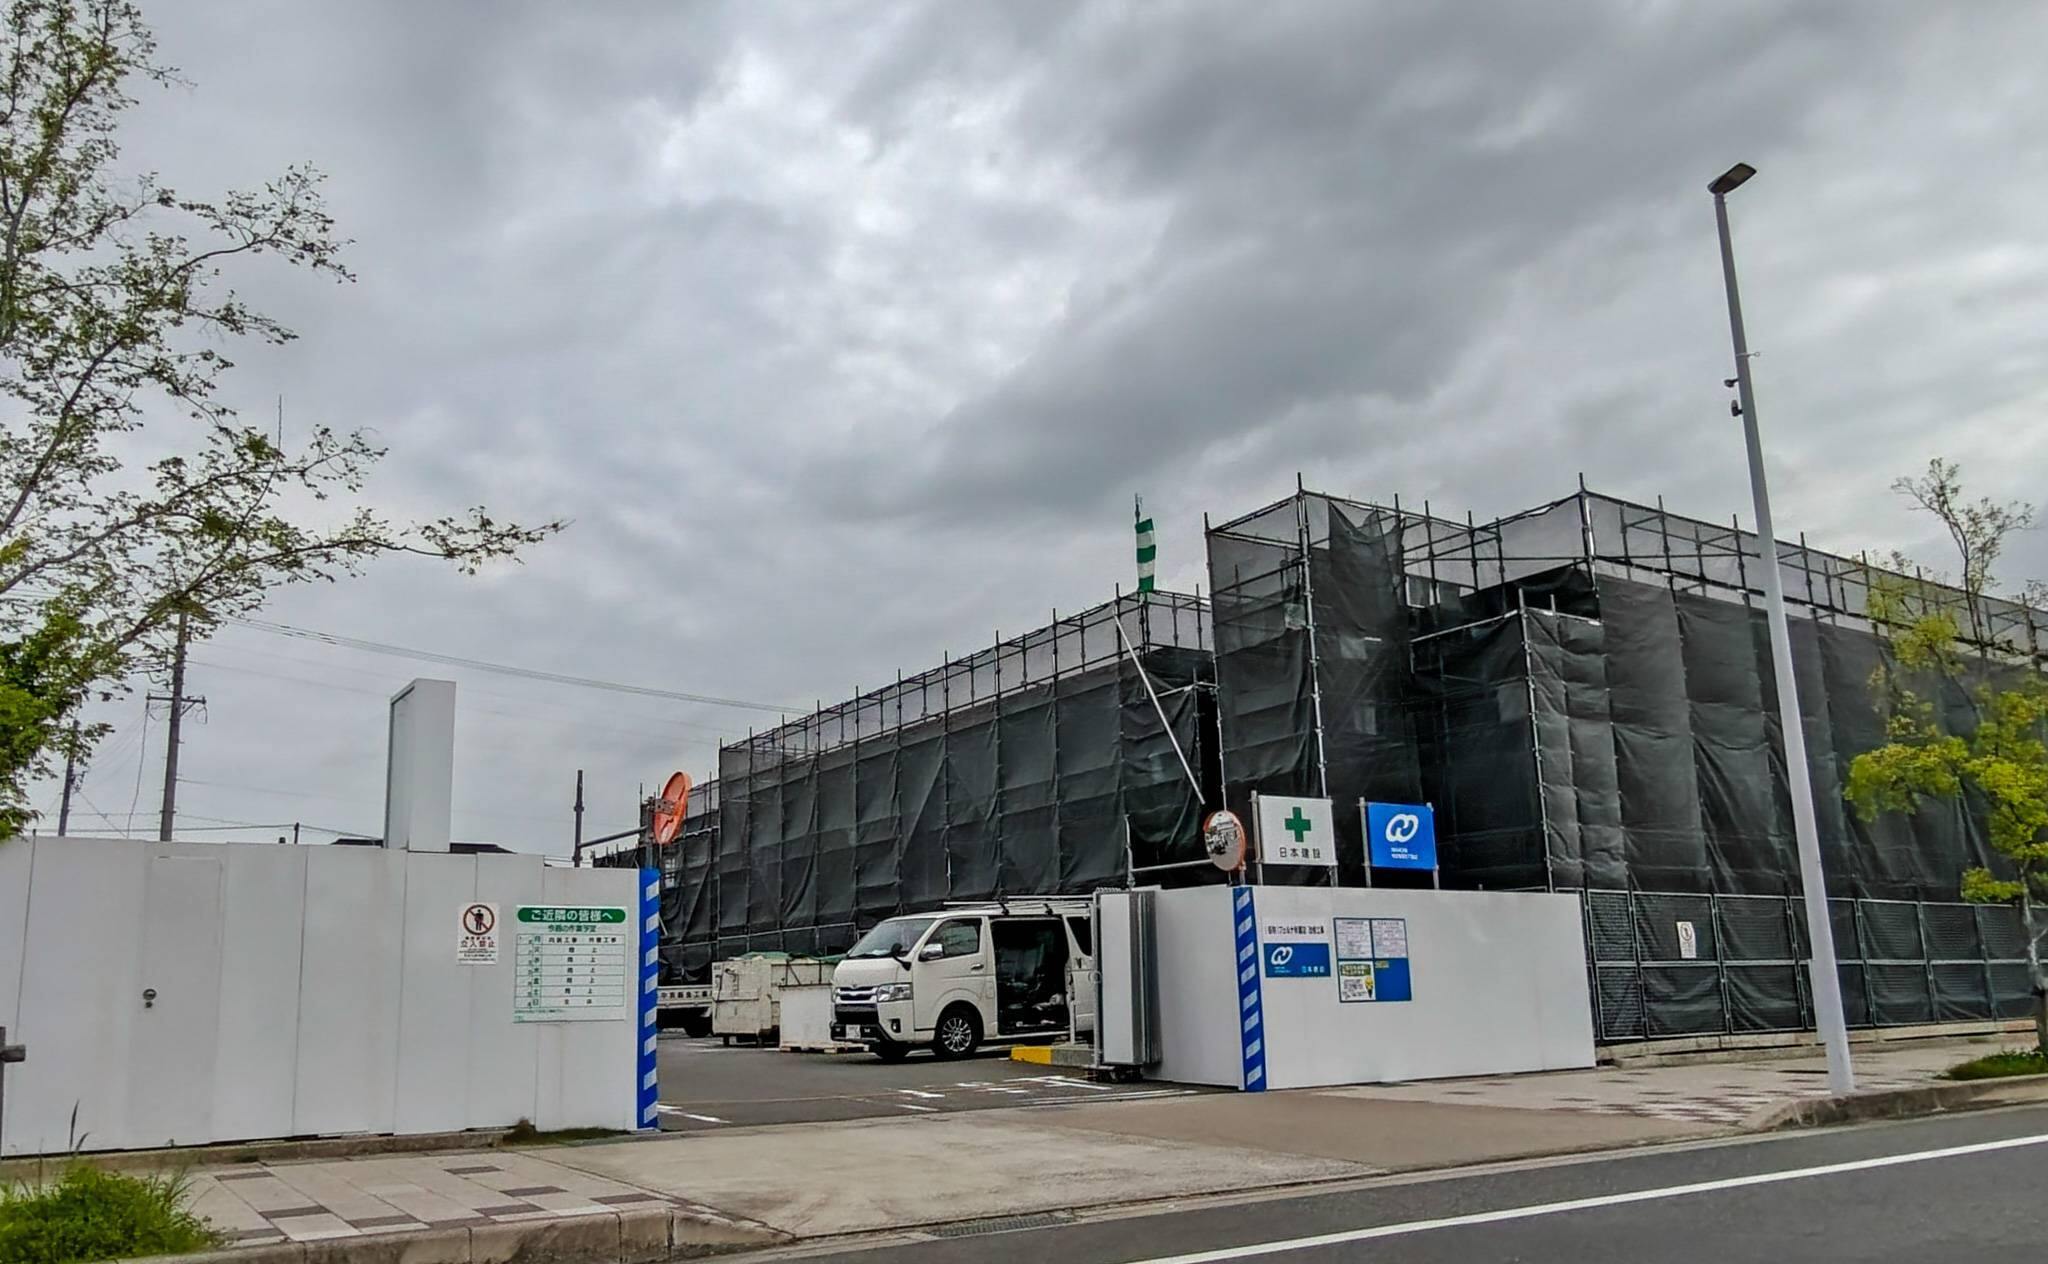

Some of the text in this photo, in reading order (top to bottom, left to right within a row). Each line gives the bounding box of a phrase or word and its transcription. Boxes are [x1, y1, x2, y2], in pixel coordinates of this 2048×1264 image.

[1279, 847, 1321, 859] 日本建設
[530, 909, 613, 922] ご近隣の皆様へ
[460, 940, 496, 948] 立入禁止
